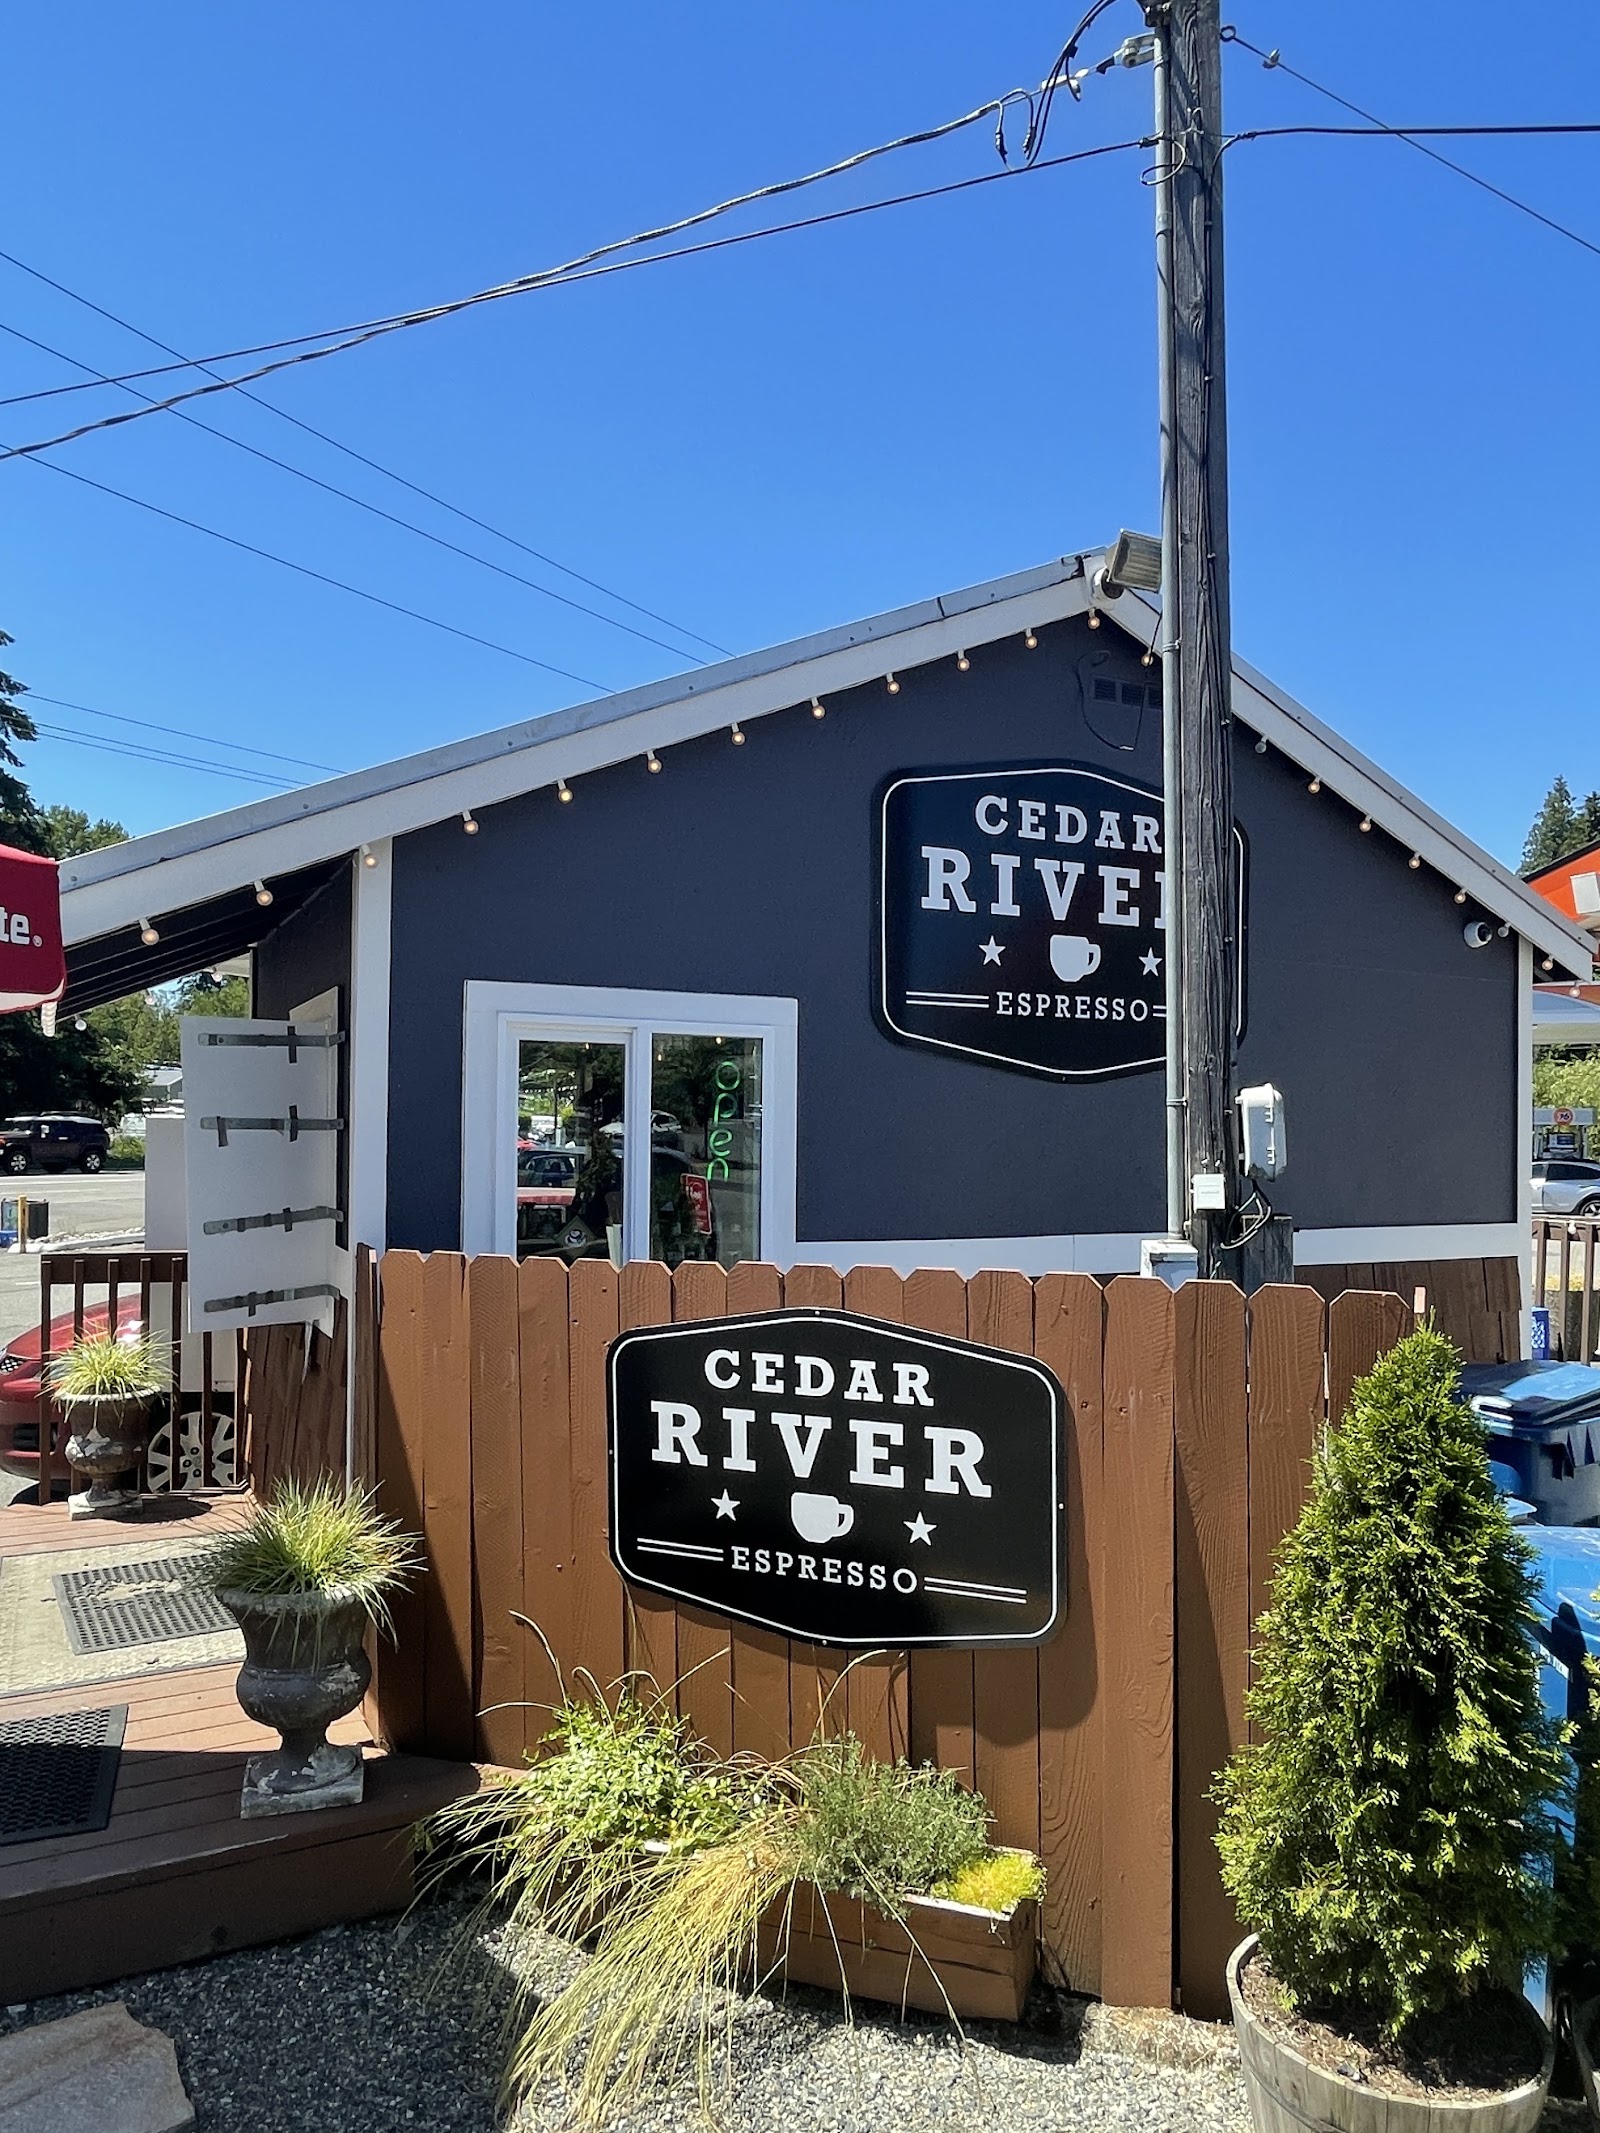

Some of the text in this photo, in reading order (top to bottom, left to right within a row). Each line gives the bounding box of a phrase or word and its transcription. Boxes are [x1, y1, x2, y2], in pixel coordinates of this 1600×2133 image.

[975, 795, 1164, 854] CEDAR
[920, 845, 1167, 930] RIVE
[996, 991, 1149, 1022] ESPRESSO
[704, 1349, 935, 1407] CEDAR
[650, 1400, 993, 1498] RIVER
[730, 1545, 918, 1594] ESPRESSO
